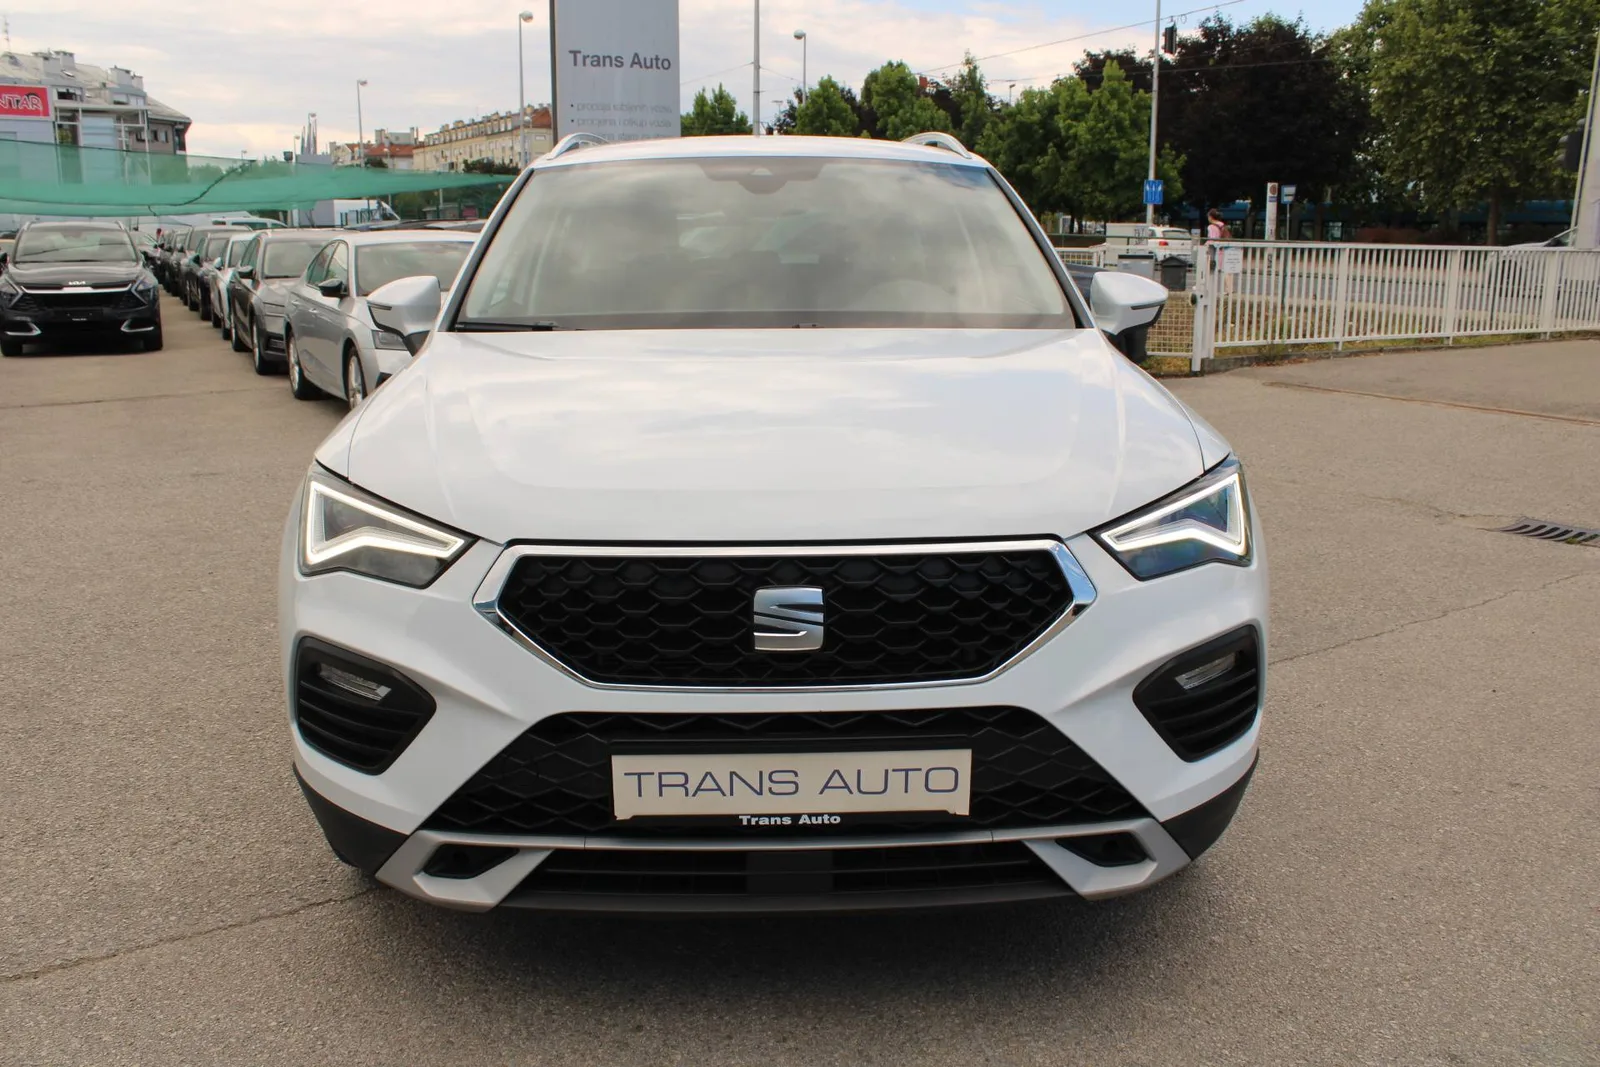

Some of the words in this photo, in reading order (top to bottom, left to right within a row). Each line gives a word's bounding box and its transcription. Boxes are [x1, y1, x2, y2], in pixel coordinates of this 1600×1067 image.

[568, 50, 624, 68] Trans
[630, 53, 671, 71] Auto
[623, 769, 800, 798] TRANS
[818, 766, 960, 796] AUTO
[739, 814, 792, 826] Trans
[798, 813, 842, 825] Auto
